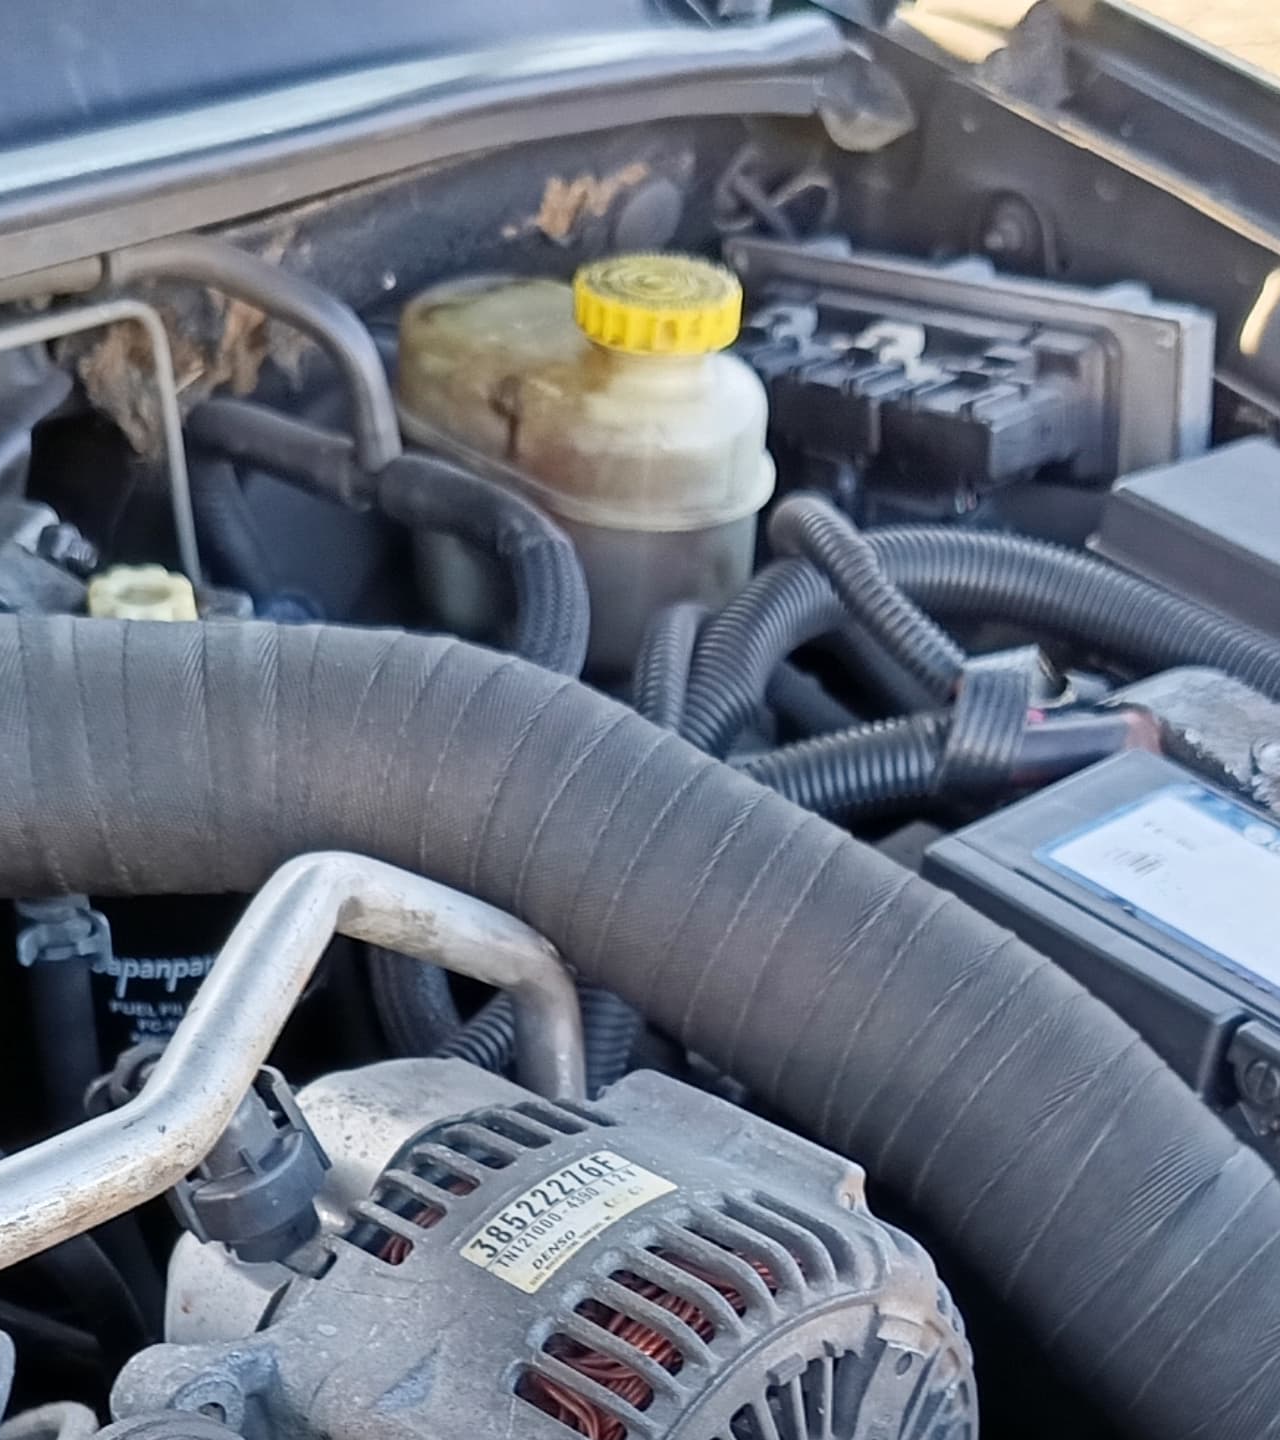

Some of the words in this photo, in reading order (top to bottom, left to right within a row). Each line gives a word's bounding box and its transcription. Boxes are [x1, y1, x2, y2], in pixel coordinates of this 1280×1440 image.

[91, 954, 218, 998] apanpar
[470, 1154, 617, 1260] 38522276F
[496, 1186, 601, 1269] TN121000-4390
[531, 1230, 576, 1271] DENSO
